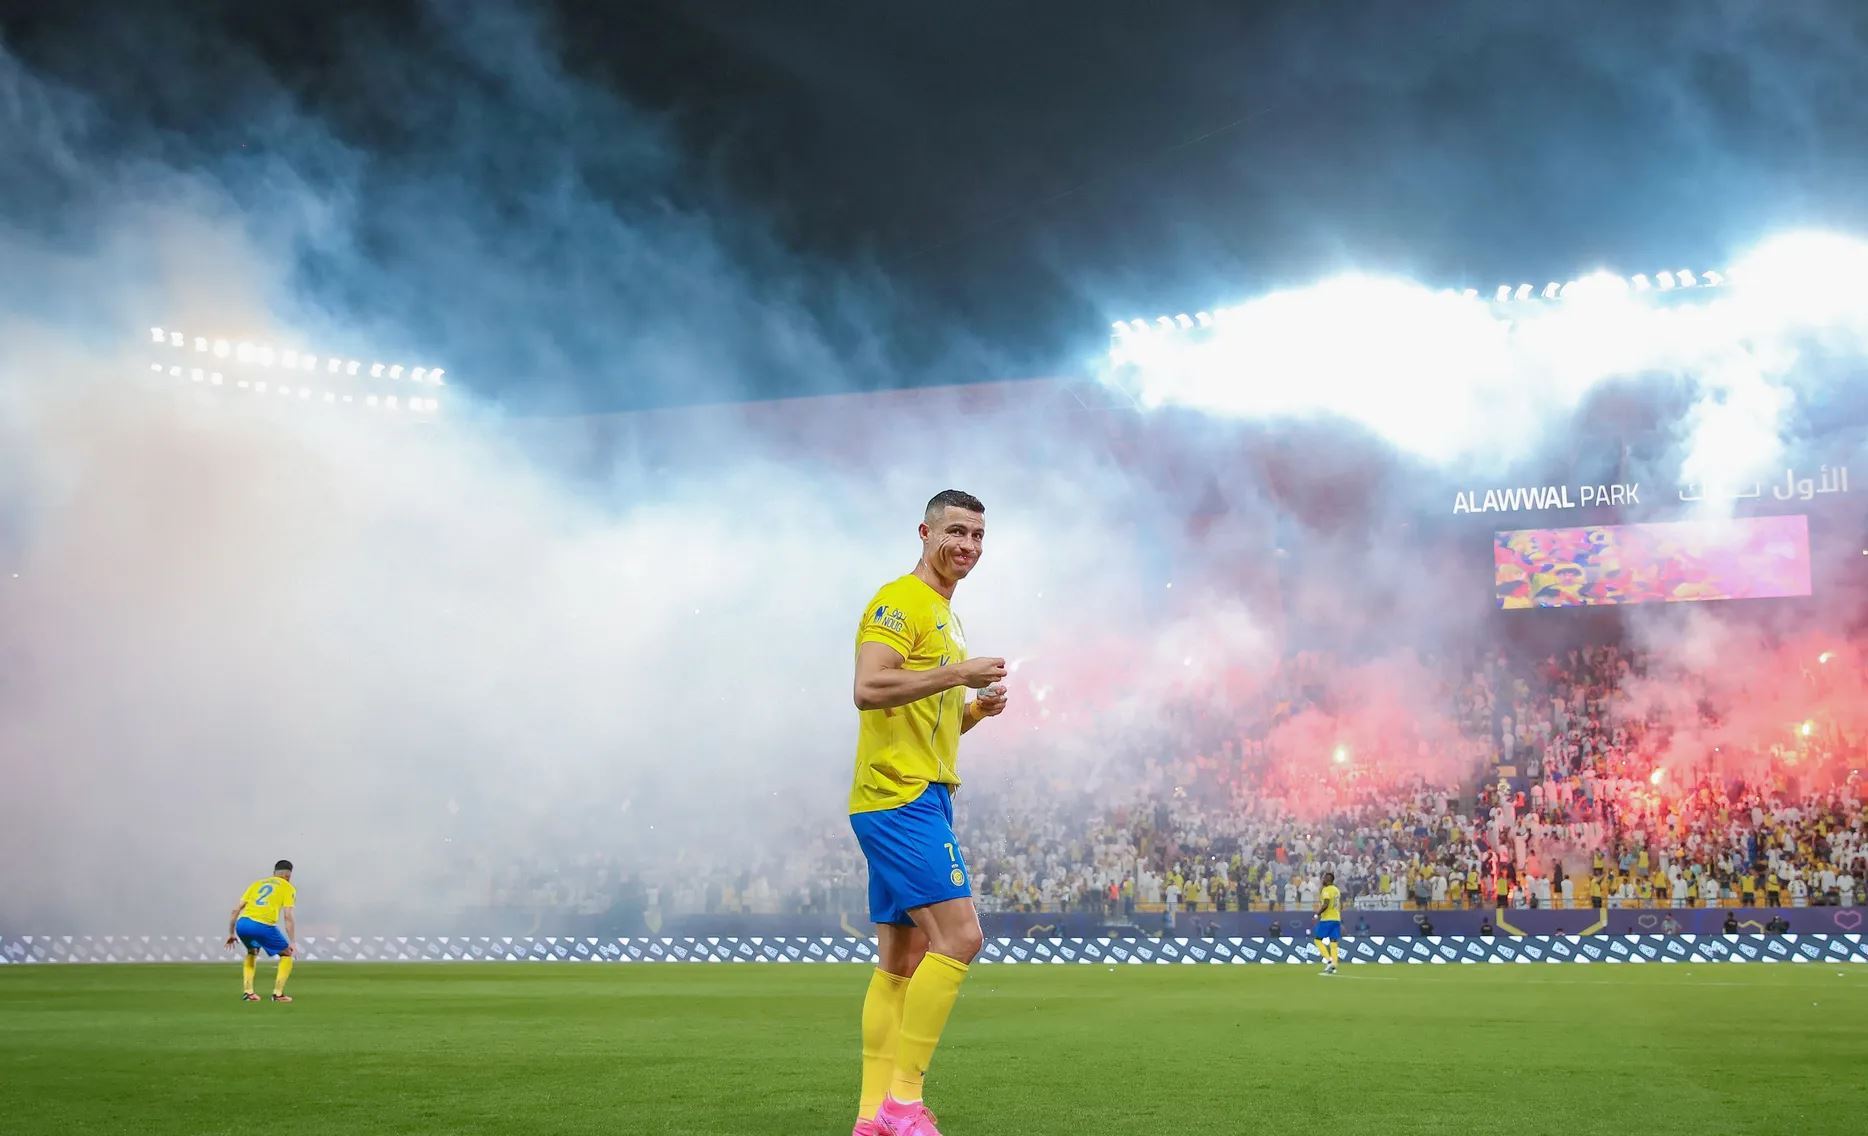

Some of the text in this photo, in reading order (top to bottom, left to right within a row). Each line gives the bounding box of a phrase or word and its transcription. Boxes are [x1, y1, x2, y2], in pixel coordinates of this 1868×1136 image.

[1453, 482, 1640, 514] ALAWWAL PARK
[1773, 464, 1848, 501] الأول
[256, 885, 273, 905] 2
